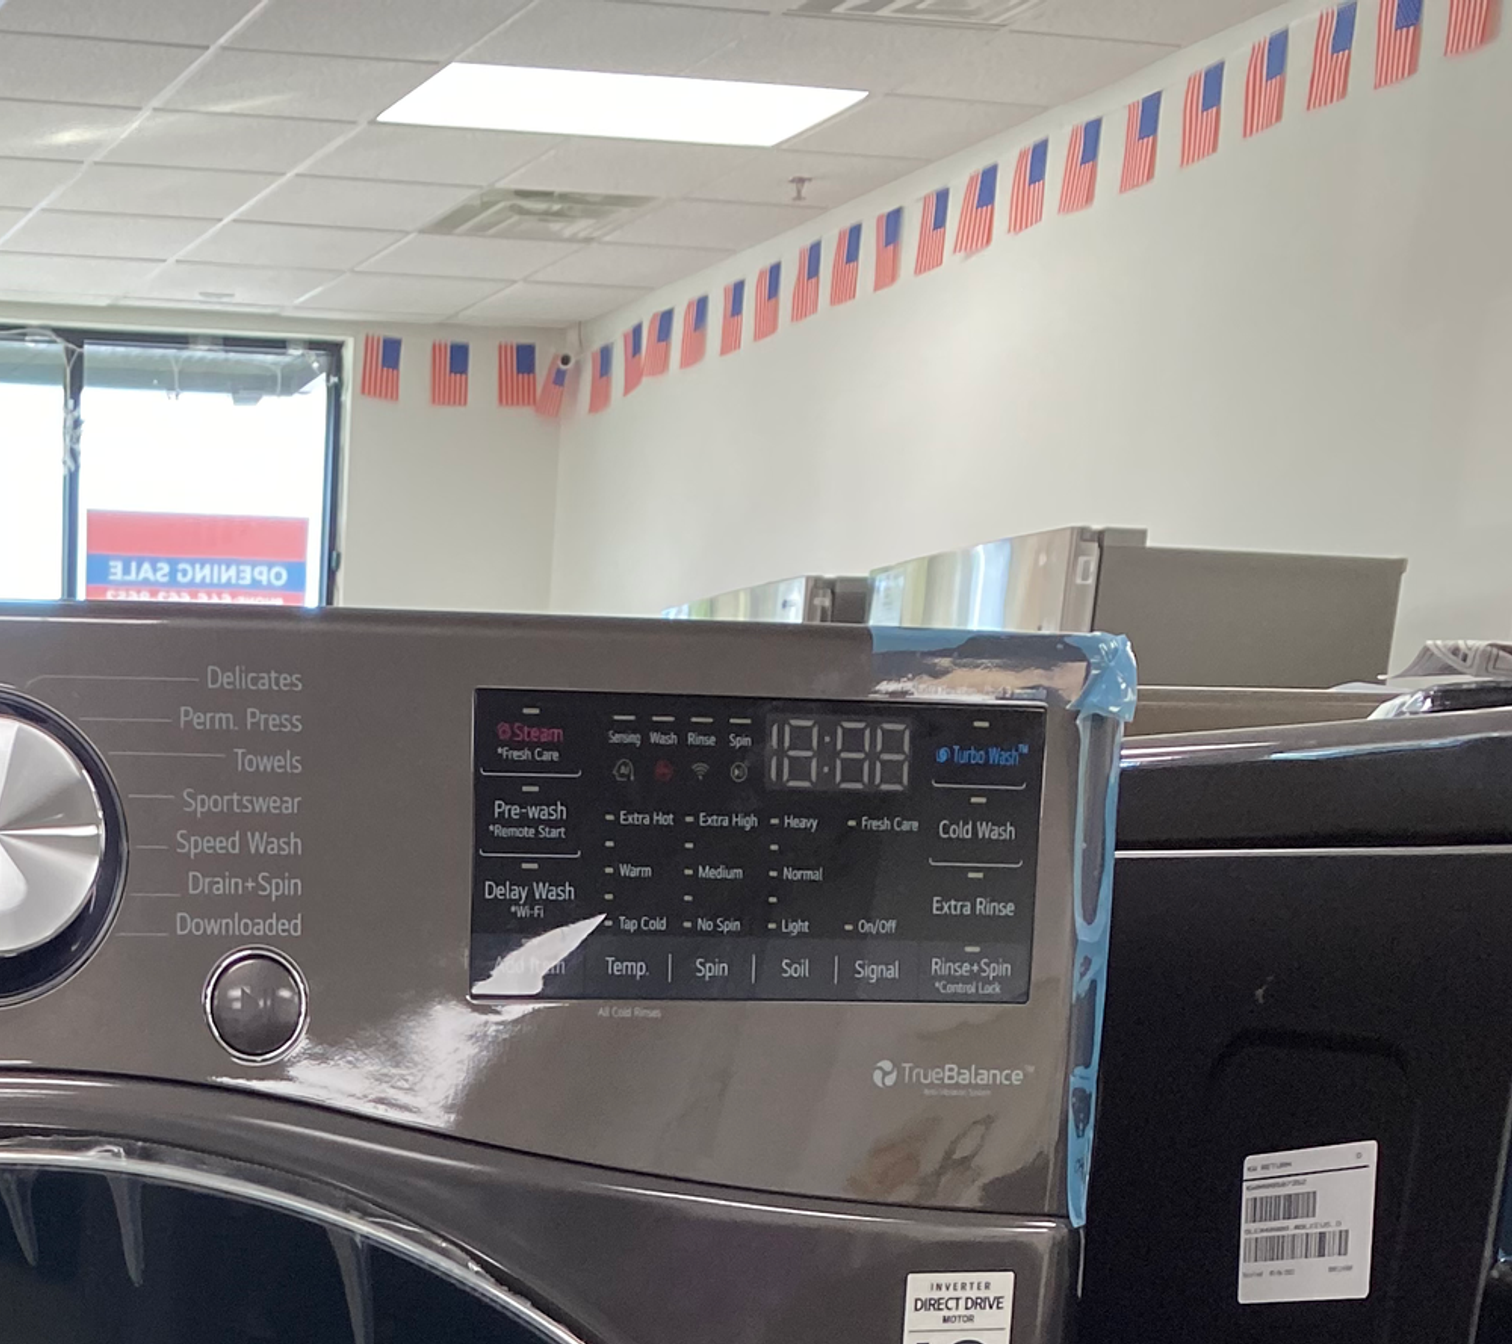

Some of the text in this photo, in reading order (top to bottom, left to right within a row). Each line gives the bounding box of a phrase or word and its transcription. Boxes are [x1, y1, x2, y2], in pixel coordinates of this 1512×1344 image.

[207, 666, 303, 691] Delicates
[180, 707, 303, 733] Perm. Press
[512, 723, 564, 743] Steam
[608, 731, 641, 747] Sensing
[649, 731, 678, 745] Wash
[687, 732, 716, 747] Rinse
[729, 733, 752, 749] Spin
[233, 749, 303, 774] Towels
[534, 749, 559, 762] Care
[953, 745, 985, 765] Turbo
[183, 789, 302, 818] Sportswear
[494, 801, 567, 820] Pre-wash
[620, 812, 674, 826] Extra Hot
[699, 813, 758, 830] Extra High
[784, 815, 818, 832] Heavy
[861, 817, 919, 832] Fresh Care
[538, 825, 566, 839] Start
[939, 820, 1016, 840] Cold Wash
[176, 831, 303, 859] Speed Wash
[619, 864, 652, 878] Warm
[698, 865, 743, 879] Medium
[783, 867, 823, 881] Normal
[189, 872, 303, 901] Drain+Spin
[484, 881, 575, 903] Delay Wash
[932, 897, 1015, 916] Extra Rinse
[176, 913, 302, 937] Downloaded
[619, 917, 667, 932] Tap Cold
[697, 918, 741, 934] No Spin
[781, 920, 809, 936] Light
[858, 920, 897, 934] On/Off
[605, 956, 649, 979] Temp.
[695, 958, 729, 981] Spin
[781, 959, 809, 978] Soil
[854, 960, 900, 983] Signal
[931, 958, 1012, 979] Rinse+Spin
[978, 982, 1001, 994] Lock
[598, 1007, 662, 1019] All Cold Rinses
[930, 1281, 992, 1292] INVERTER
[914, 1296, 1005, 1312] DIRECT DRIVE
[942, 1314, 975, 1324] MOTOR
